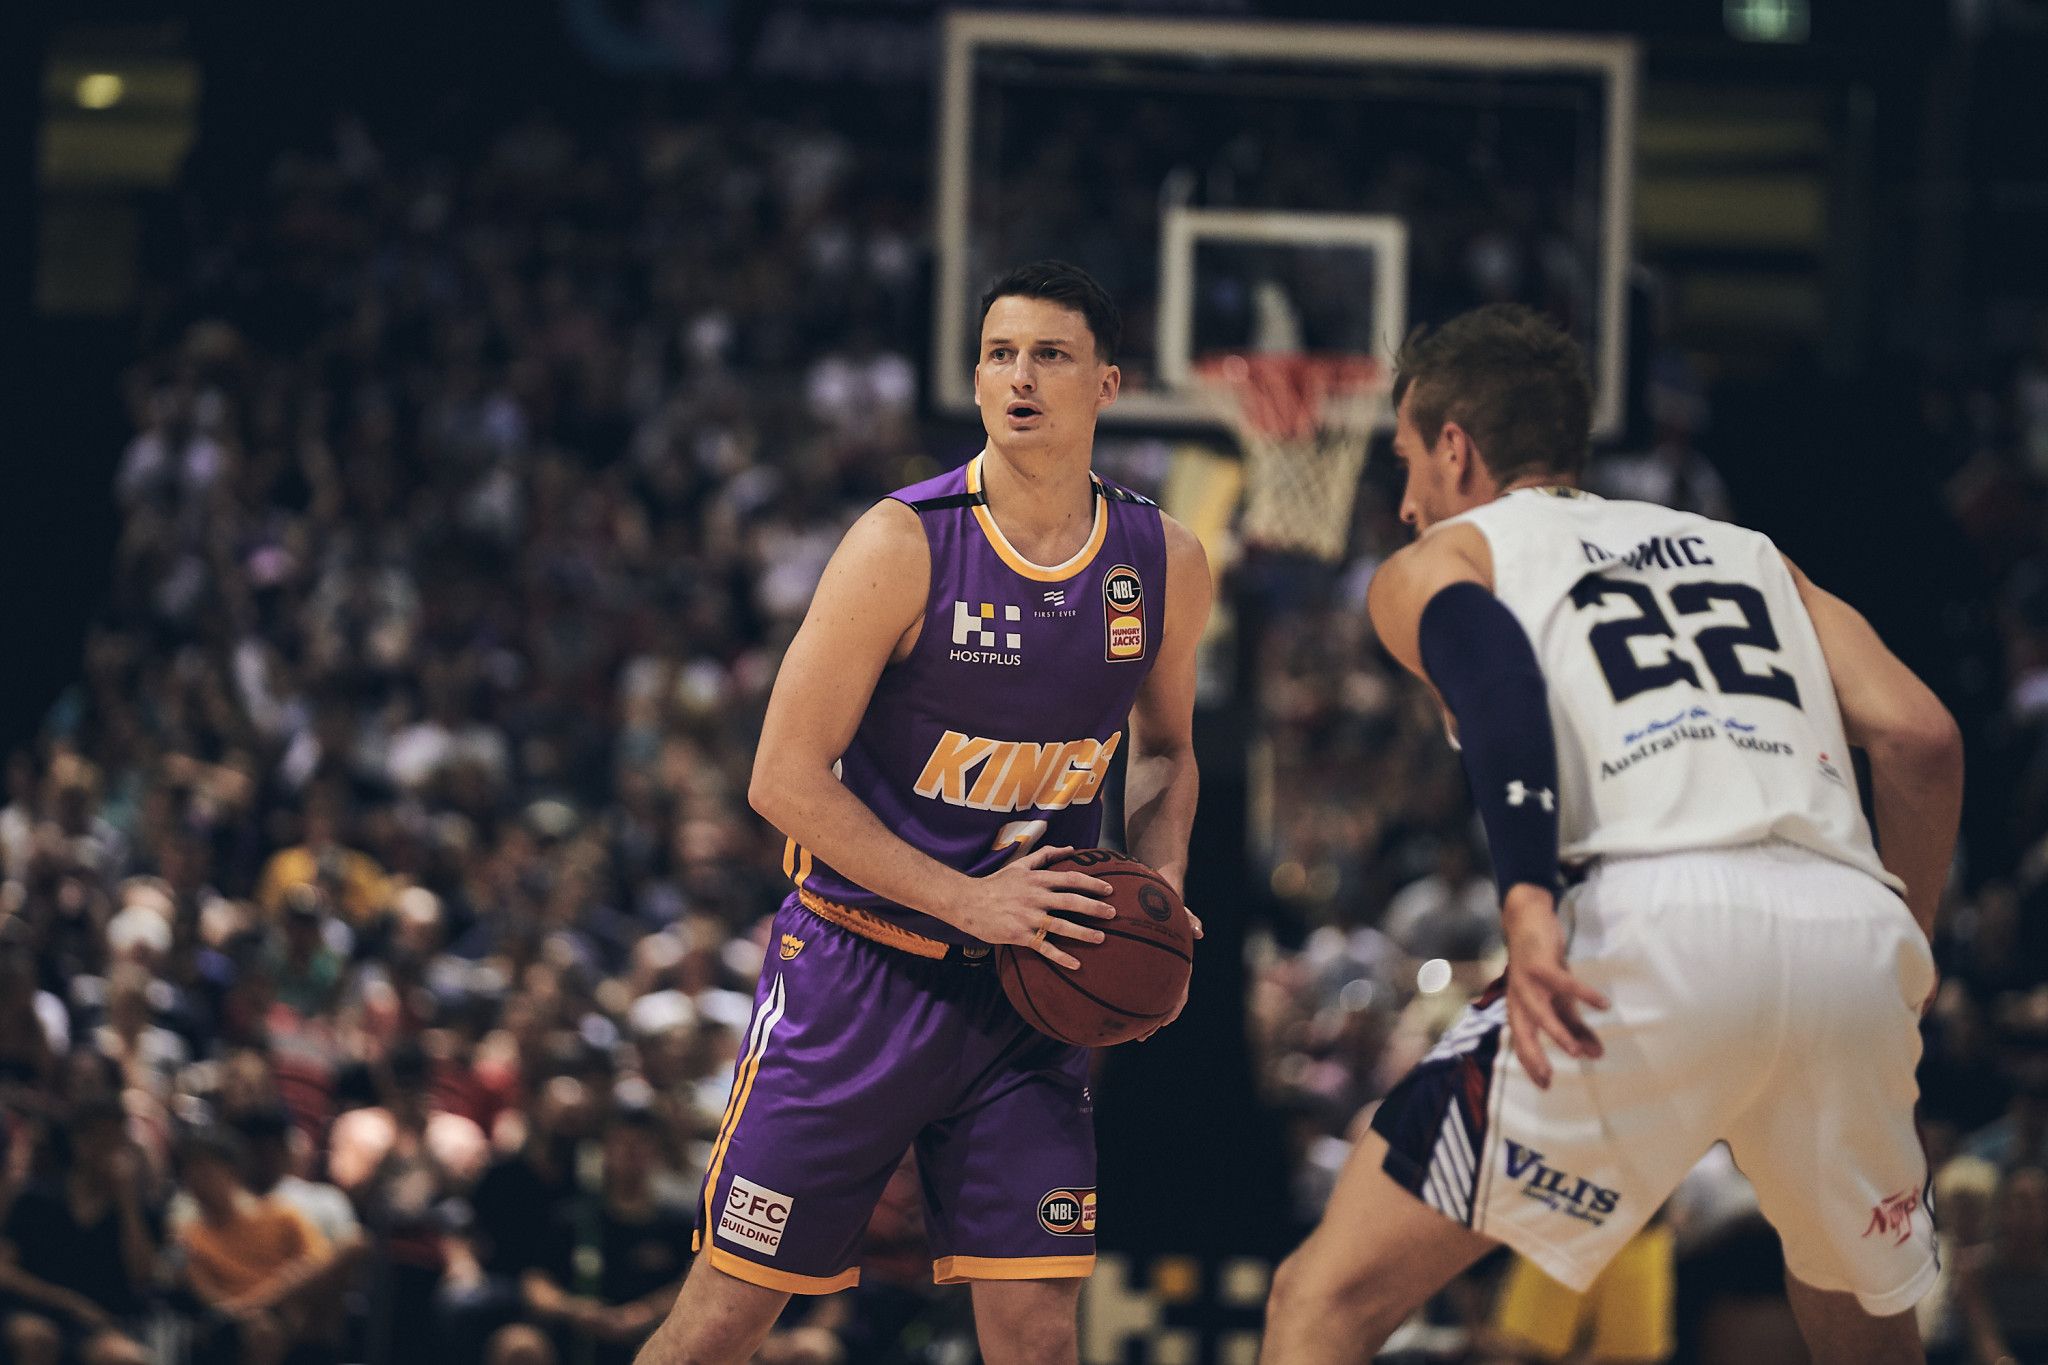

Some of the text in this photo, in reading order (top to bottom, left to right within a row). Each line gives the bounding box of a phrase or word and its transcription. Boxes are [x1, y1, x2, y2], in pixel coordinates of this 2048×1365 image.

[1112, 580, 1135, 599] NBL
[1059, 609, 1077, 617] EVER
[1112, 627, 1140, 636] HUNGRY
[1112, 636, 1140, 647] JACK'S
[1568, 571, 1804, 712] 22
[949, 650, 1021, 666] HOSTPLUS
[1728, 732, 1794, 756] otors
[1050, 1203, 1074, 1221] NBL
[721, 1217, 779, 1247] BUILDING
